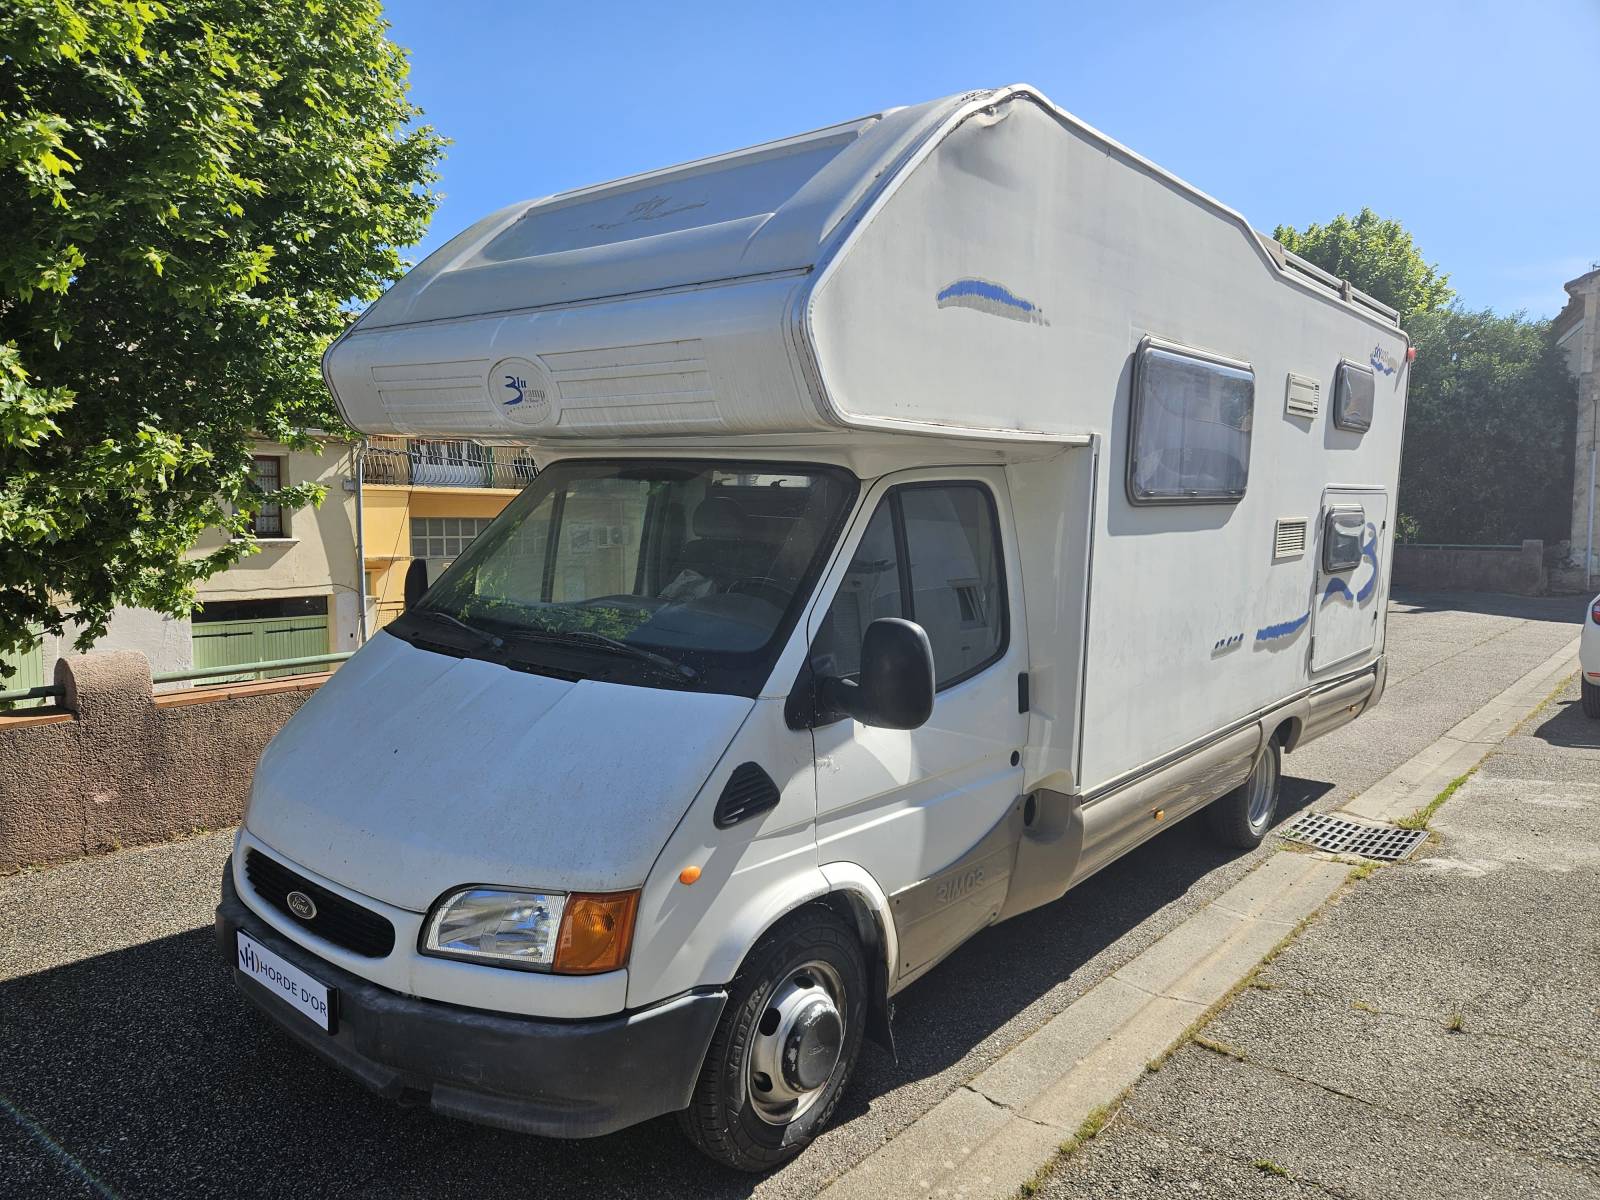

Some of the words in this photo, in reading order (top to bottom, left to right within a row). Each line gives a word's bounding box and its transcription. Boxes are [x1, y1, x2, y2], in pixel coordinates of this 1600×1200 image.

[292, 895, 310, 914] Ford
[260, 961, 298, 997] HORDE
[301, 988, 327, 1017] D'OR
